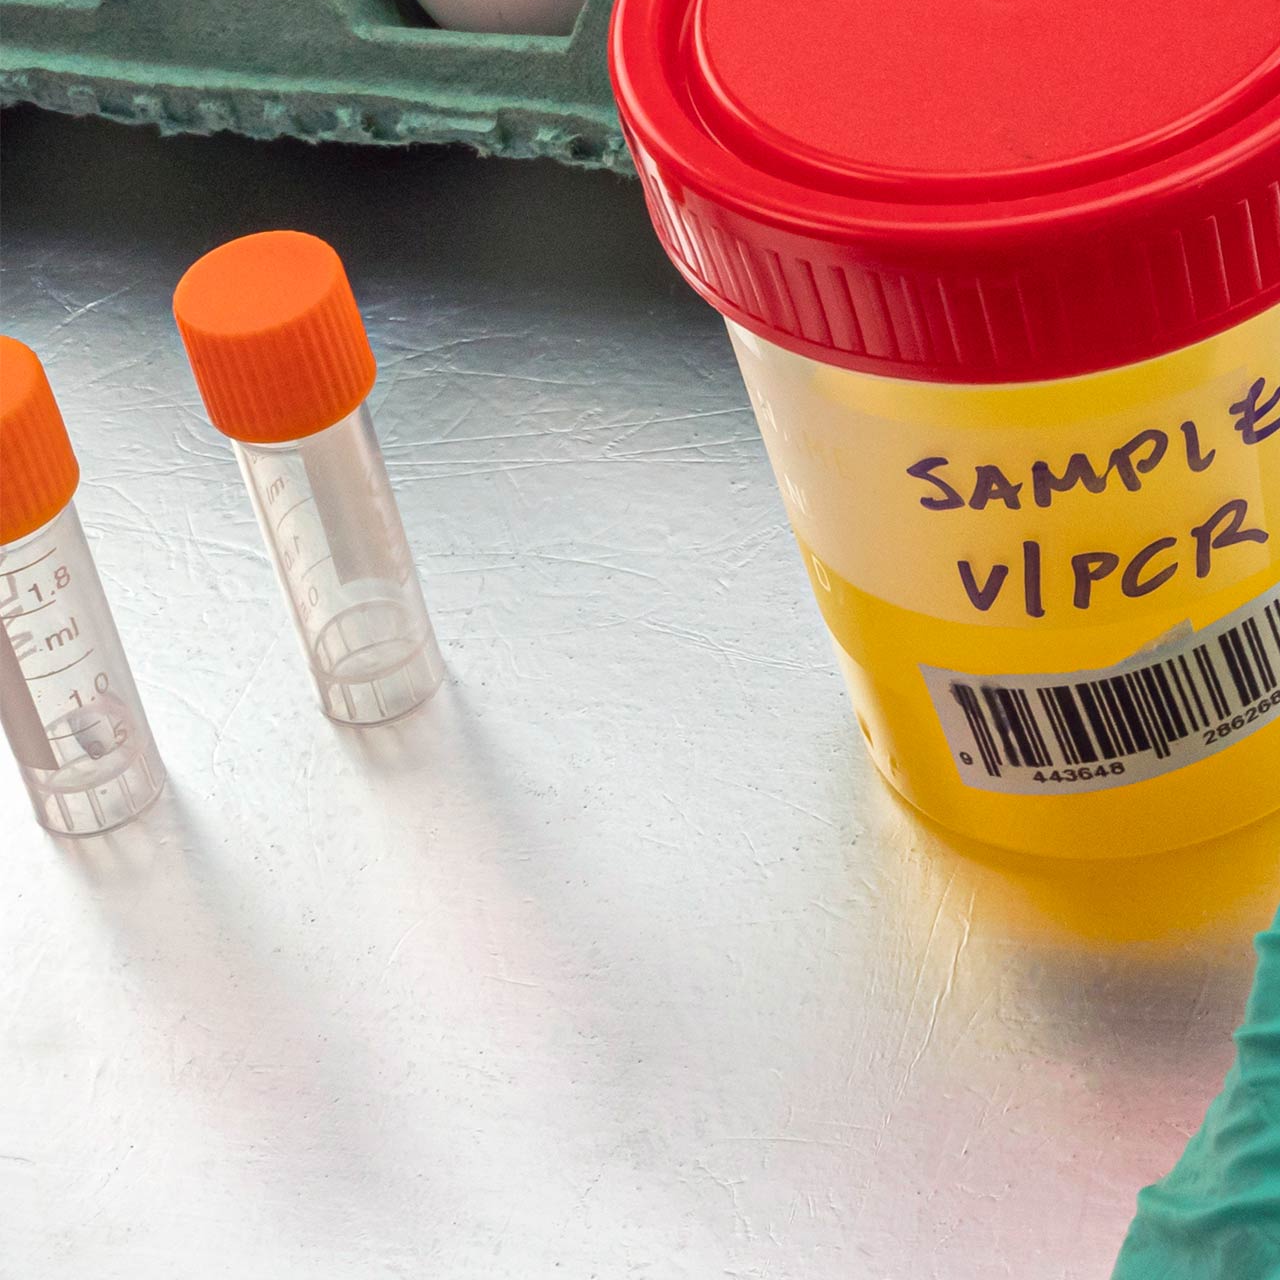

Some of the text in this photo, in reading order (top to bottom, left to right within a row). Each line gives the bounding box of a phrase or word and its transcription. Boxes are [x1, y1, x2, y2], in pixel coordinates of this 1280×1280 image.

[27, 565, 71, 603] 1.8
[69, 671, 109, 708] 1.0
[958, 751, 974, 766] 9
[1032, 761, 1125, 784] 443648
